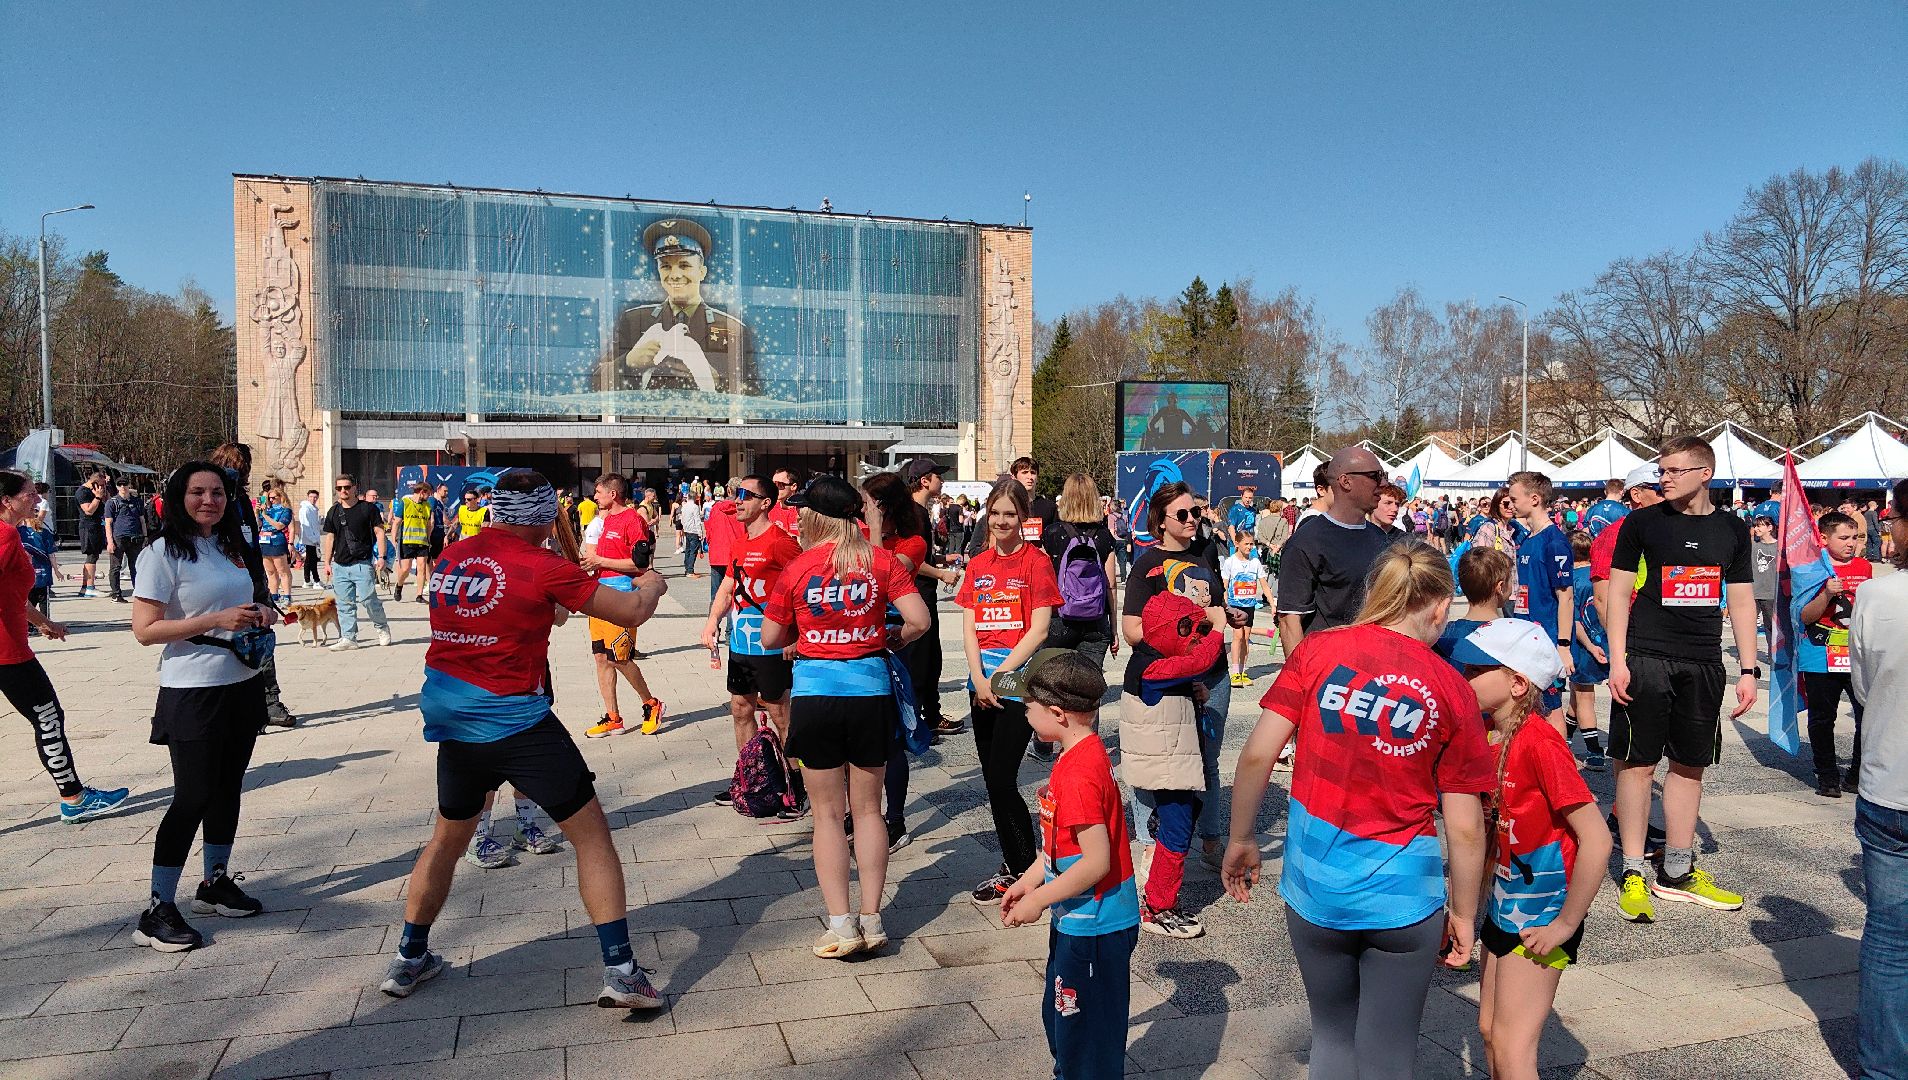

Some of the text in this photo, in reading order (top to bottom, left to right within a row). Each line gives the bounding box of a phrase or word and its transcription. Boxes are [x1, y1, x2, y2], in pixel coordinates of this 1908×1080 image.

[1801, 480, 1829, 488] РАЦИЯ
[1555, 555, 1568, 570] 7
[429, 572, 493, 597] БЕГИ
[455, 556, 506, 618] КРАСНОЗНАМЕНСК
[807, 582, 868, 604] БЕГИ
[1674, 583, 1710, 597] 2011
[982, 606, 1012, 621] 2123
[432, 629, 499, 647] ЛЕКСАНДР
[1834, 656, 1850, 666] 20
[1319, 683, 1426, 734] БЕГИ
[32, 700, 62, 740] JUST
[42, 740, 68, 770] DO
